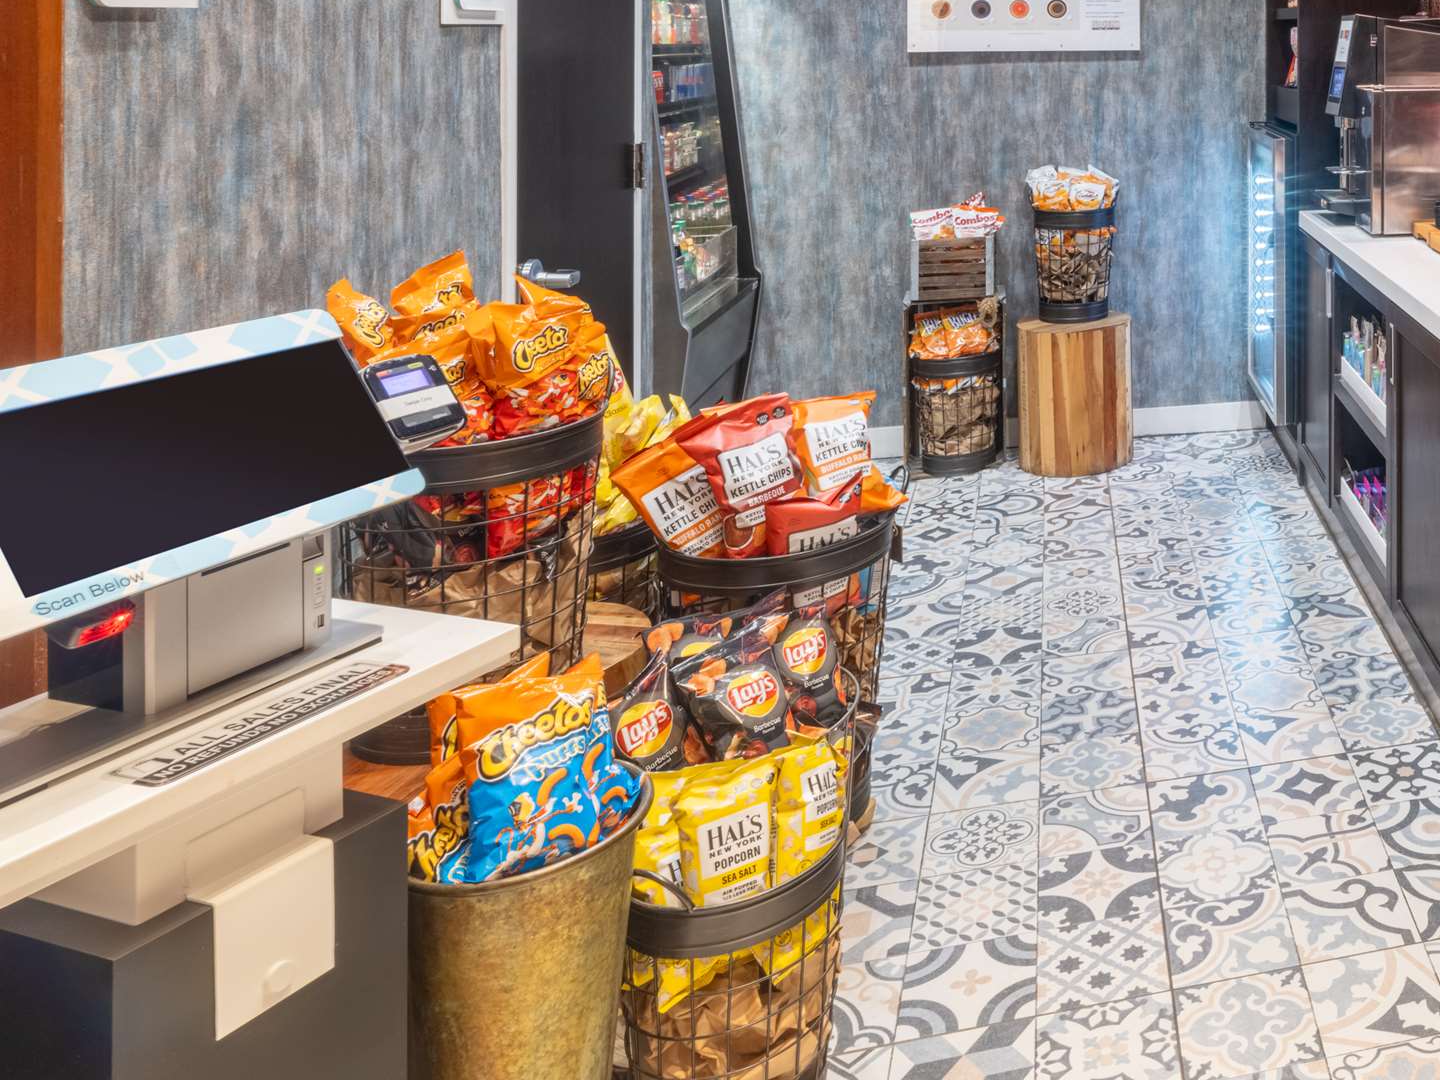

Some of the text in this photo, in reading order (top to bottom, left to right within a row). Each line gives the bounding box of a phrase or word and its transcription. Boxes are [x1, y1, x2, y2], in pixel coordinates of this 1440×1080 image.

[955, 214, 995, 226] Combos
[727, 443, 782, 476] HAL'S
[815, 445, 848, 463] KETTLE
[654, 471, 710, 515] HAL'S
[730, 467, 792, 499] KETTLE CHIPS
[733, 471, 754, 484] NEW
[663, 505, 685, 521] NEW
[663, 498, 717, 537] KETTLE CHI
[34, 570, 146, 617] Scan Below
[784, 632, 826, 669] Lay's
[731, 676, 778, 710] Lay's
[153, 669, 393, 779] NO REFUNDS NO EXCHANGES
[174, 667, 377, 755] ALL SALES FINAL
[753, 717, 782, 733] Barbecue
[477, 697, 593, 781] Cheetos
[621, 706, 669, 753] Lay's
[645, 746, 679, 771] Barbecue
[706, 814, 763, 851] HAL'S
[708, 834, 763, 860] NEW YORK
[714, 845, 761, 872] POPCORN
[721, 865, 758, 886] SEA SALT
